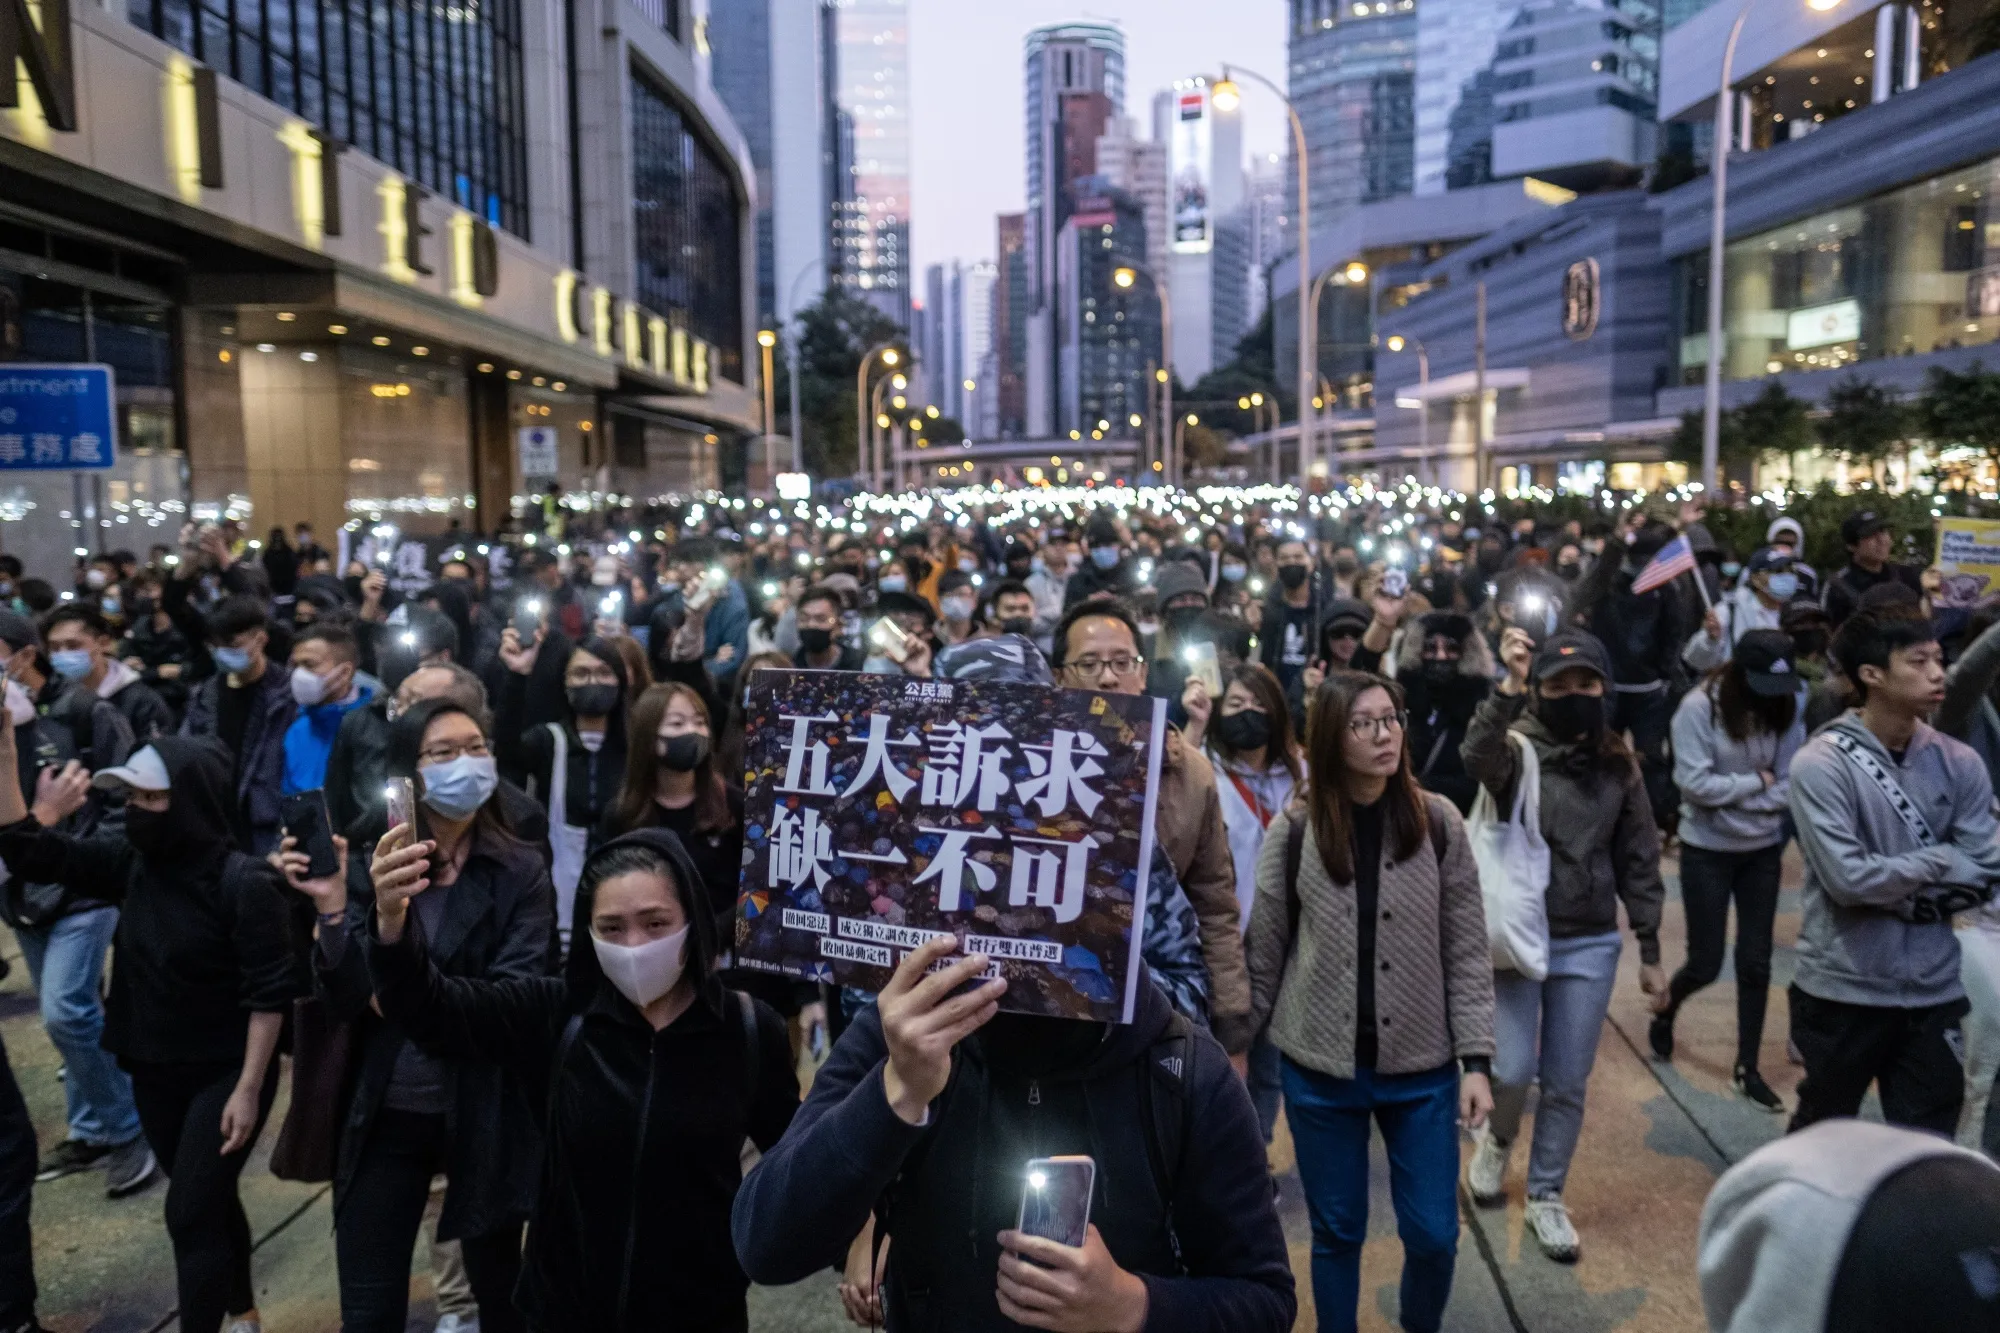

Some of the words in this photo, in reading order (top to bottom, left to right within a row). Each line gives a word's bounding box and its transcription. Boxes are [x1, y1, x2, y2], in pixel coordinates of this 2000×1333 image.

[904, 682, 954, 699] 公民黨
[773, 710, 1109, 818] 五大訴求
[768, 803, 1100, 924] 缺一不可
